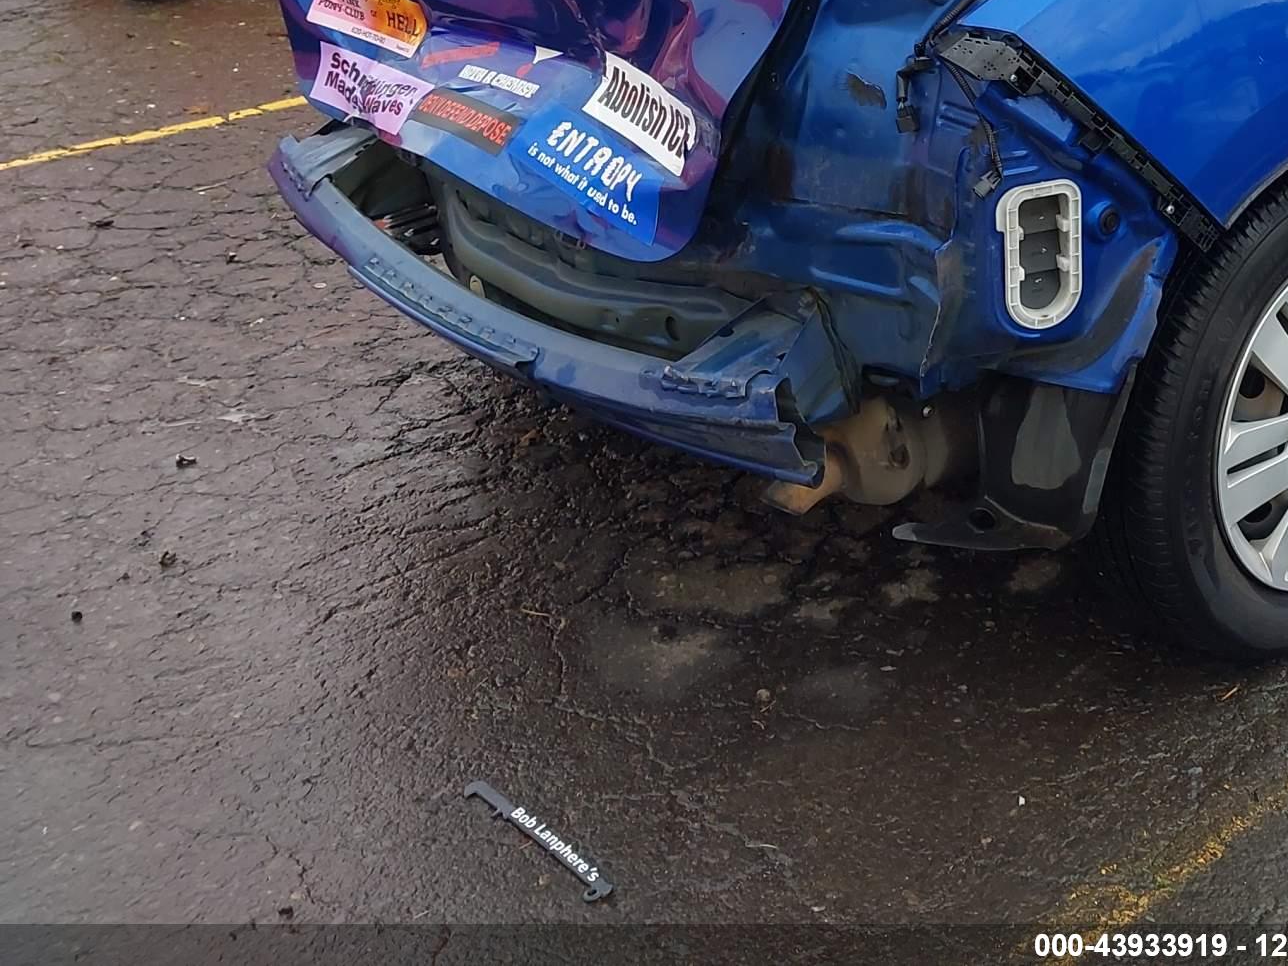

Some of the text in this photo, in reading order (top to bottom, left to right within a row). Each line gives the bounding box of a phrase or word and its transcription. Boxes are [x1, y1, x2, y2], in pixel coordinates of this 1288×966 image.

[385, 10, 421, 37] HELL
[598, 65, 668, 141] Abolish
[527, 142, 539, 157] is
[537, 152, 556, 169] not
[554, 164, 580, 186] what
[577, 176, 589, 192] it
[607, 198, 620, 214] to
[620, 203, 638, 226] be.
[547, 121, 642, 203] ENTROPY
[510, 806, 600, 883] Bob Lanphere's
